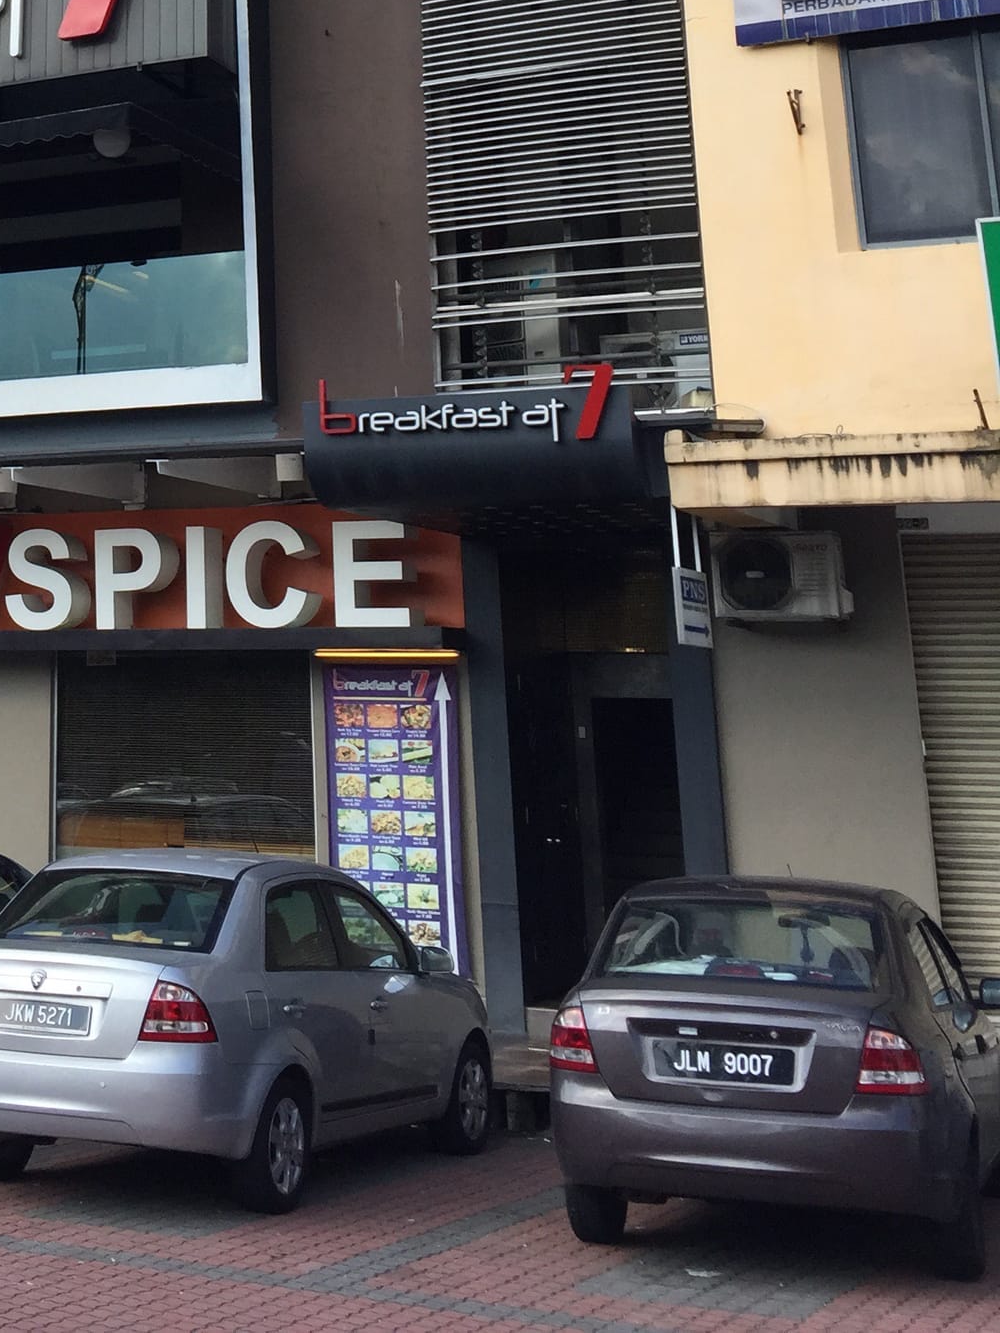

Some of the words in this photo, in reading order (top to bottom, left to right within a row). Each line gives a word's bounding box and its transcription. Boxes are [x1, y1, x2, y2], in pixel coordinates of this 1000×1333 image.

[319, 379, 516, 435] breakfast
[522, 397, 566, 443] at
[563, 362, 615, 440] 7
[5, 520, 418, 631] SPICE
[681, 579, 706, 603] PNS
[411, 669, 430, 697] 7
[5, 1003, 35, 1023] JKW
[37, 1005, 72, 1026] 5271
[673, 1049, 711, 1073] JLM
[723, 1052, 774, 1077] 9007
